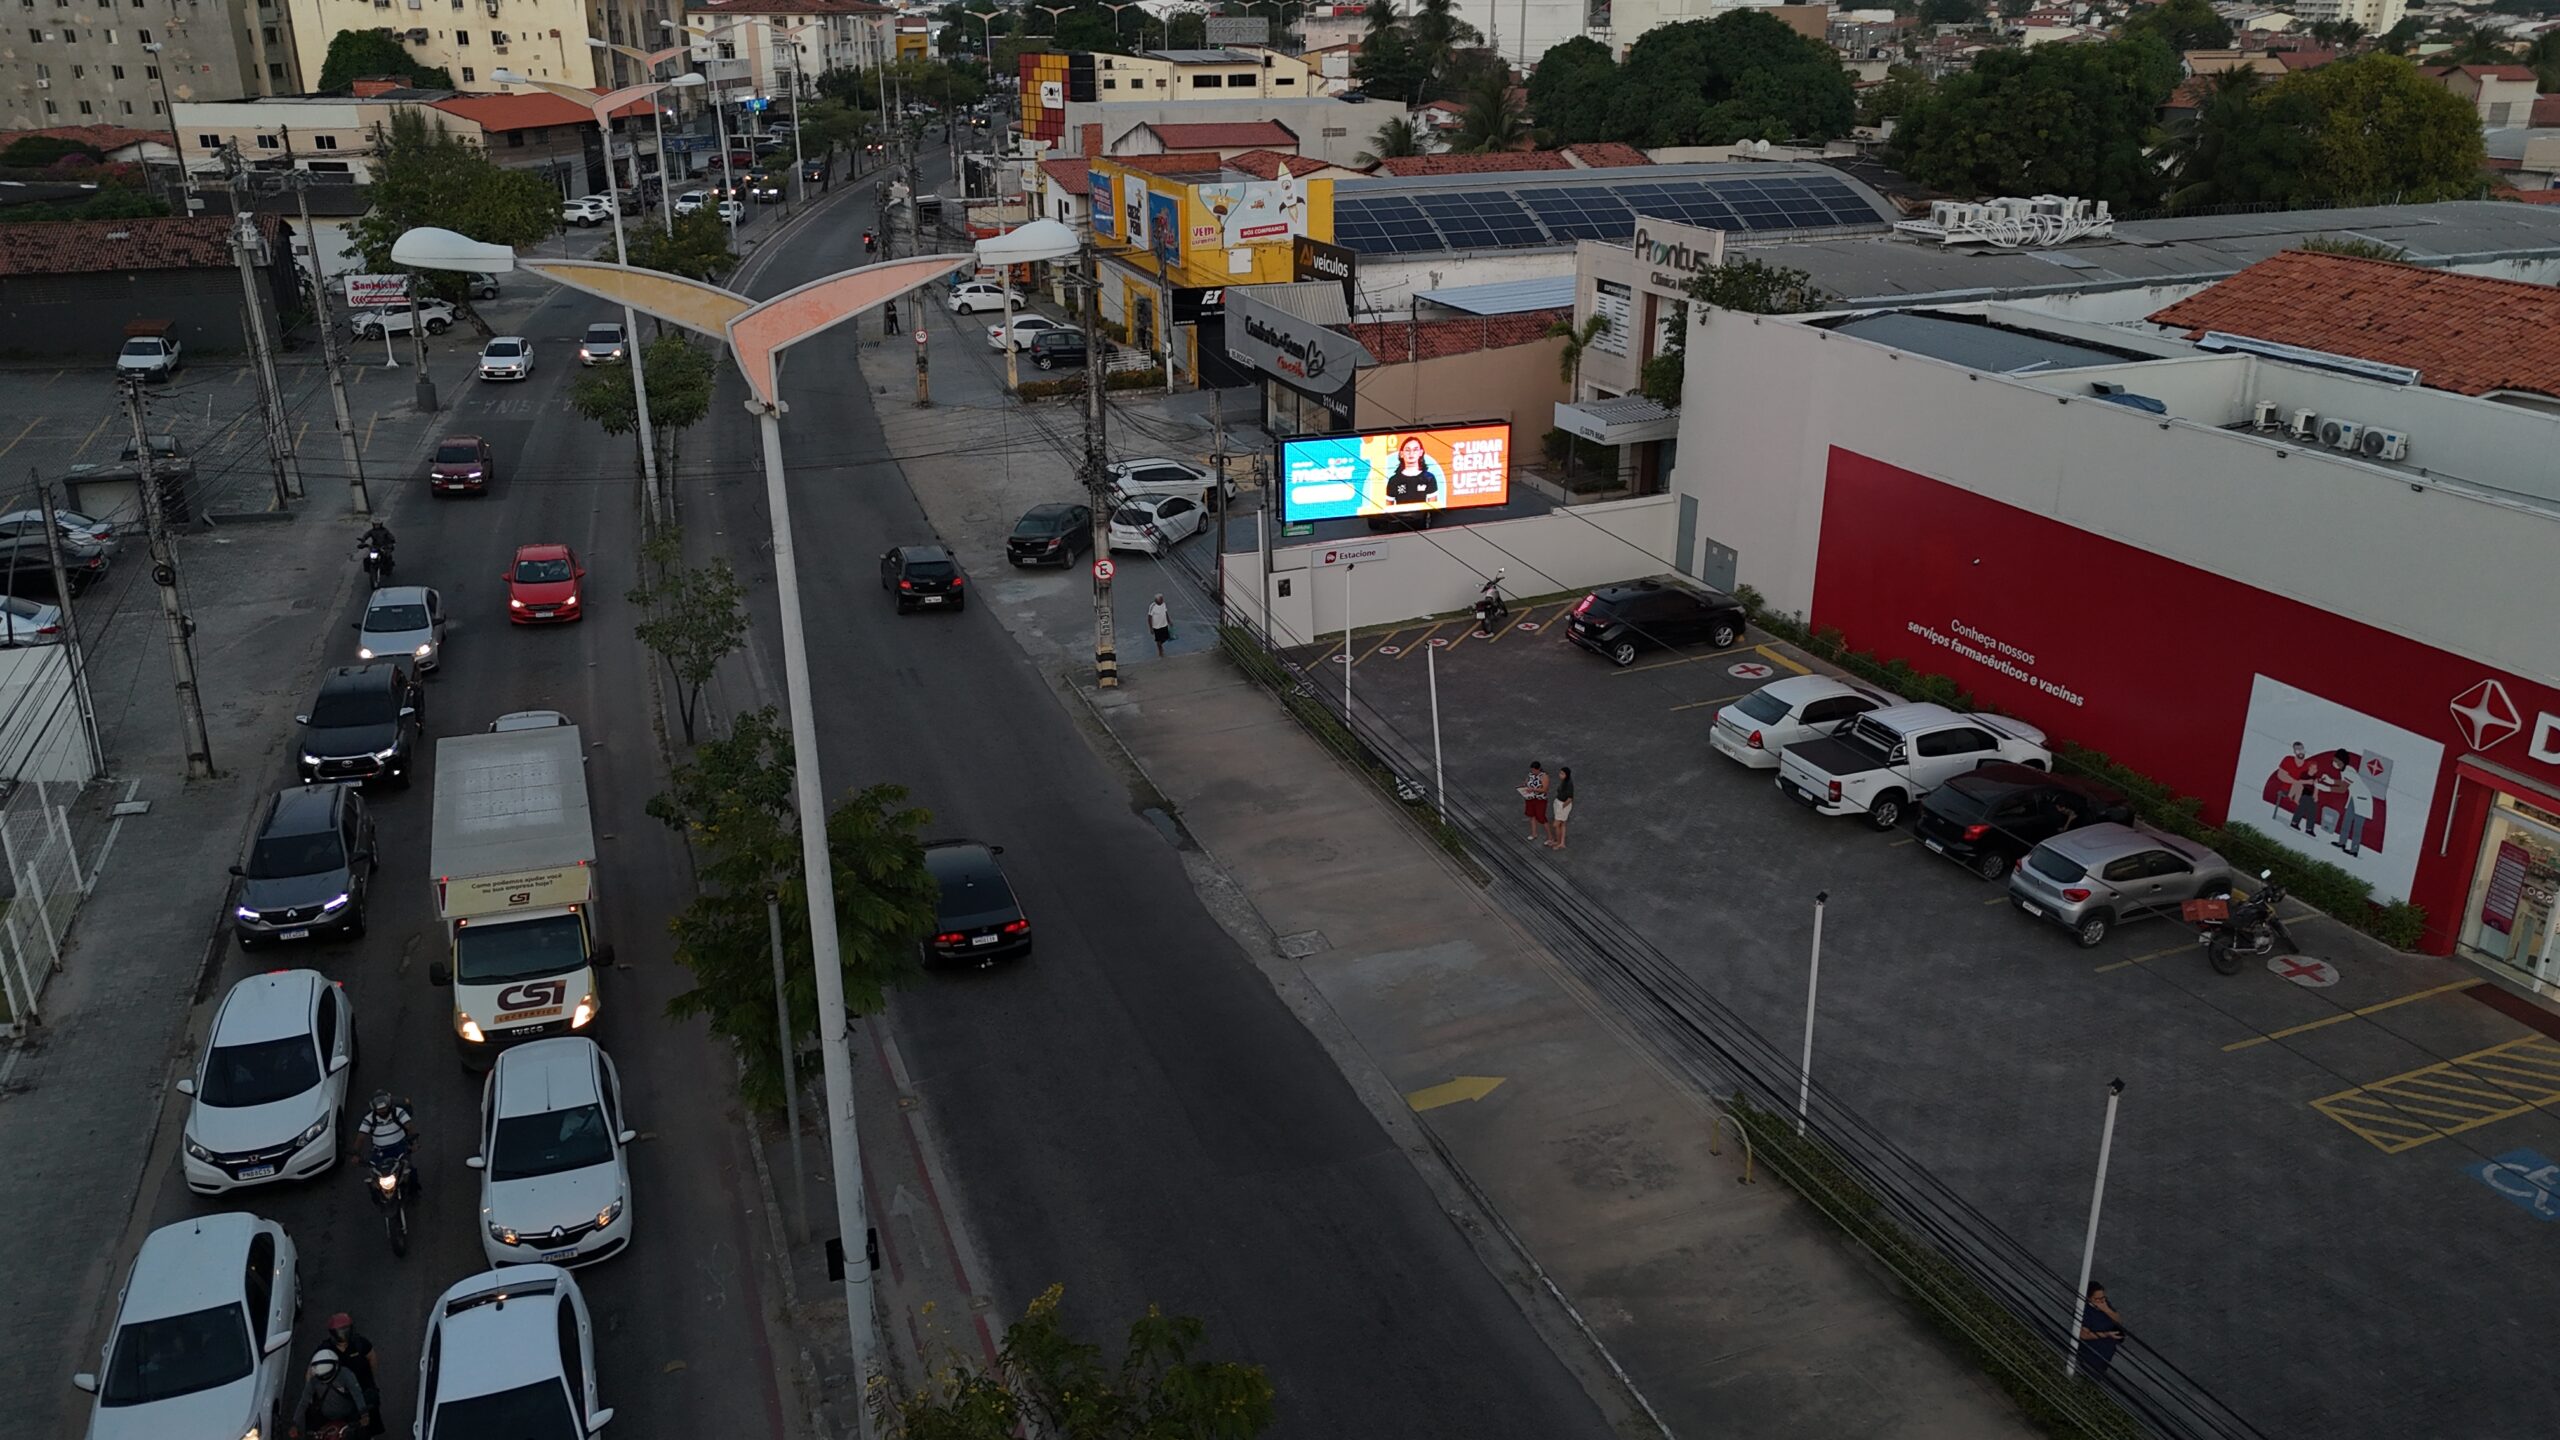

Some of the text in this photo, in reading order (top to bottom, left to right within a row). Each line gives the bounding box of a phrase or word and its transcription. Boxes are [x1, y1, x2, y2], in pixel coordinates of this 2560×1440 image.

[1193, 226, 1214, 237] VEM
[1635, 228, 1710, 275] Prontus
[1313, 252, 1349, 278] veículos
[1465, 438, 1503, 454] LUGAR
[1453, 453, 1502, 471] GERAL
[1453, 471, 1502, 488] UECE
[1339, 549, 1377, 560] Estacione
[1100, 563, 1108, 575] E
[1951, 619, 2036, 666] Conheça nossos
[1907, 621, 2085, 708] serviços farmacêuticos e vacinas
[471, 872, 563, 889] Como podemos ajudar você
[505, 882, 535, 891] empresa
[535, 879, 553, 888] hoje?
[509, 892, 531, 903] CSI
[497, 979, 567, 1011] CSI
[511, 1025, 544, 1036] IVECO
